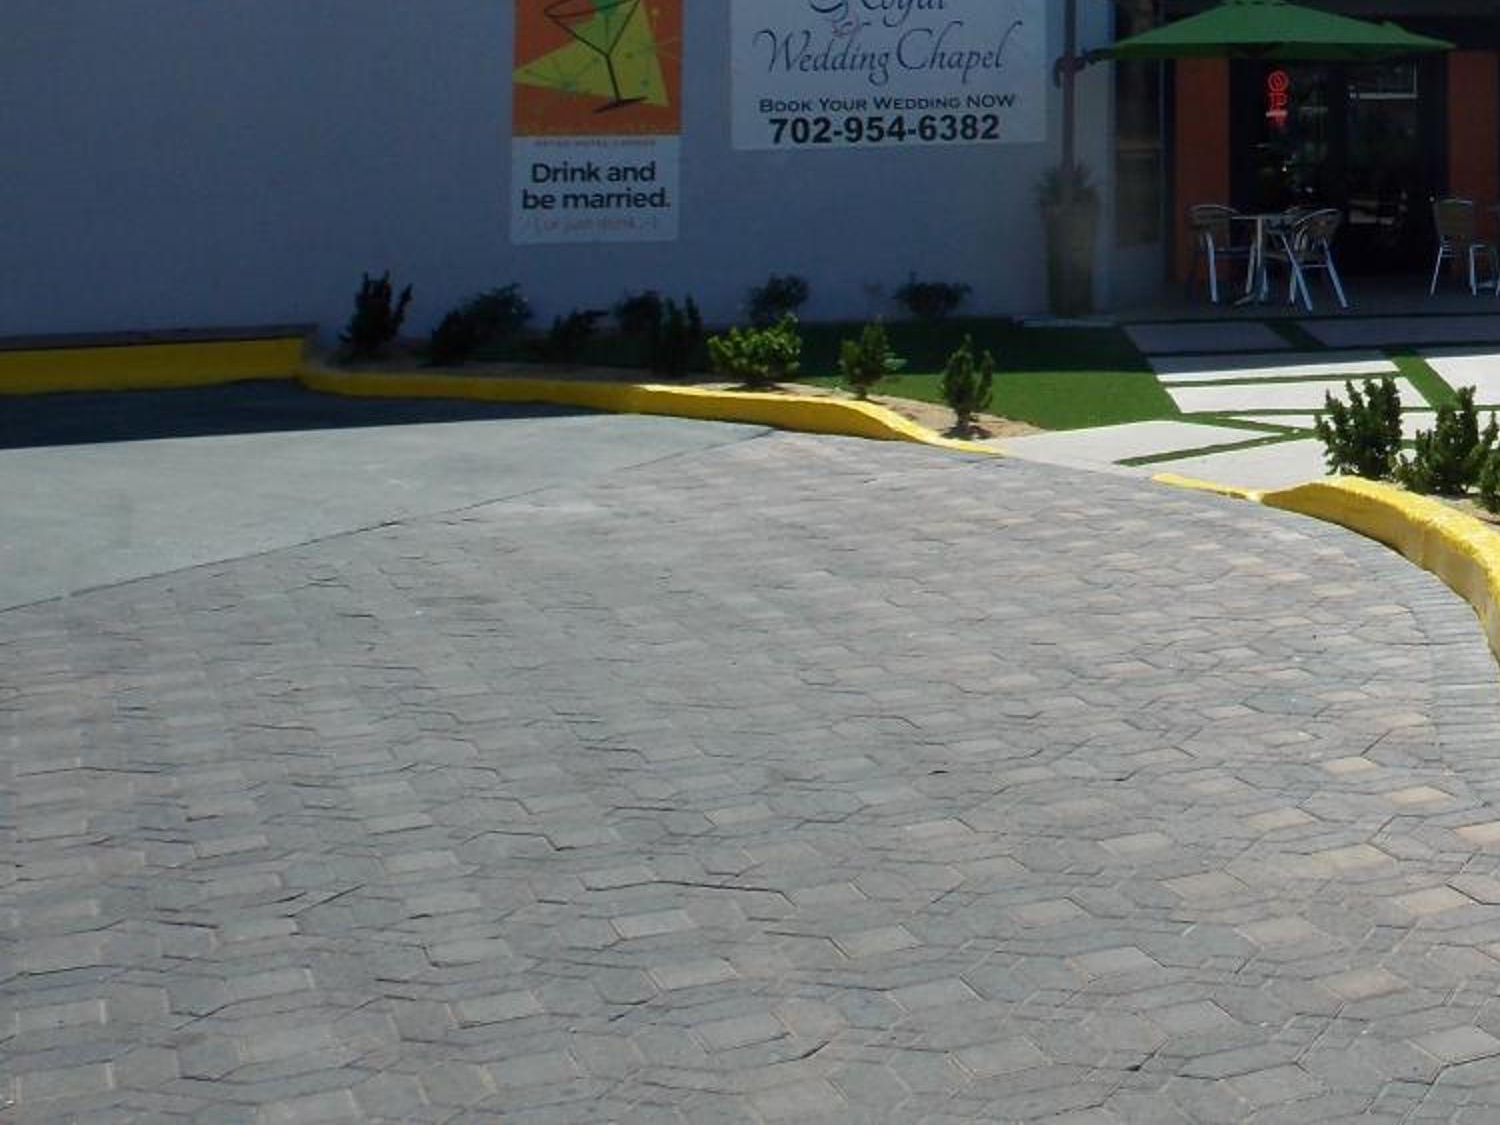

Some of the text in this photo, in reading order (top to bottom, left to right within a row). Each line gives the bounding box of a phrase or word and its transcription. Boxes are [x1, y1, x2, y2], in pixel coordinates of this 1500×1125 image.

[753, 21, 1023, 86] Wedding Chapel
[759, 93, 1017, 113] BOOK YOUR WEDDING NOW
[768, 114, 1001, 144] 702-954-6382
[532, 159, 656, 184] Drink and
[521, 186, 672, 210] be married.
